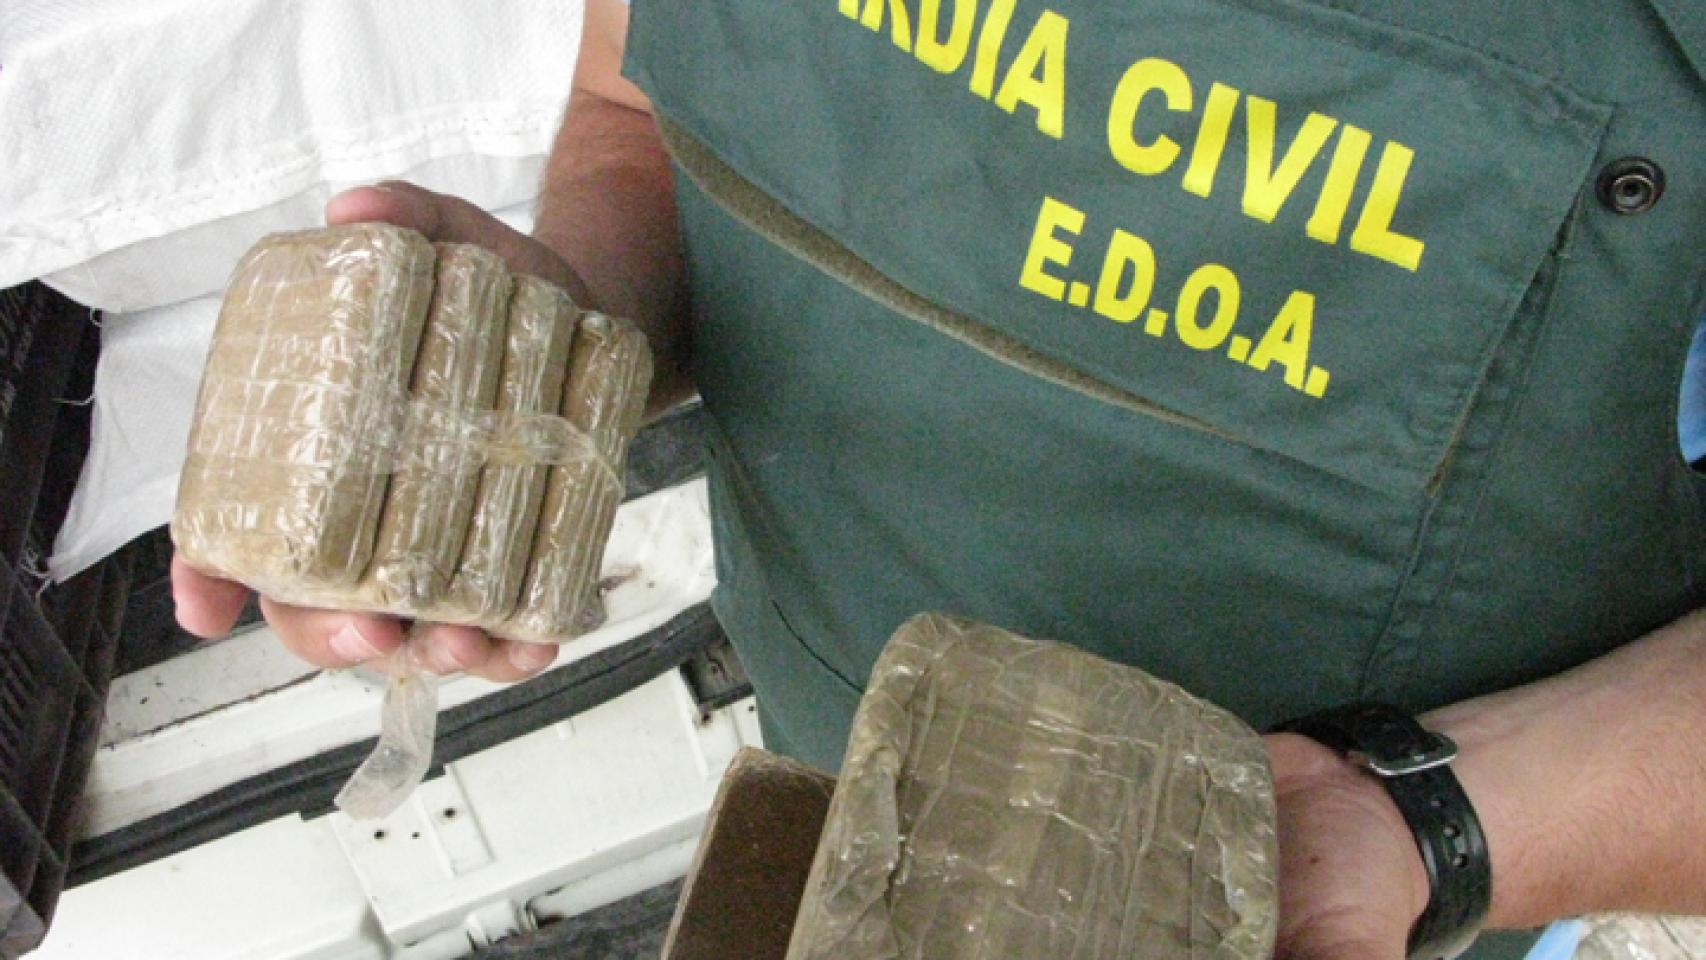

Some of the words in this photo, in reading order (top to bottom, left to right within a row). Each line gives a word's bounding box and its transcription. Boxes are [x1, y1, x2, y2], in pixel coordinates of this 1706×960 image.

[838, 0, 1069, 139] DIA
[1107, 57, 1425, 272] CIVIL
[1019, 197, 1330, 398] E.D.O.A.
